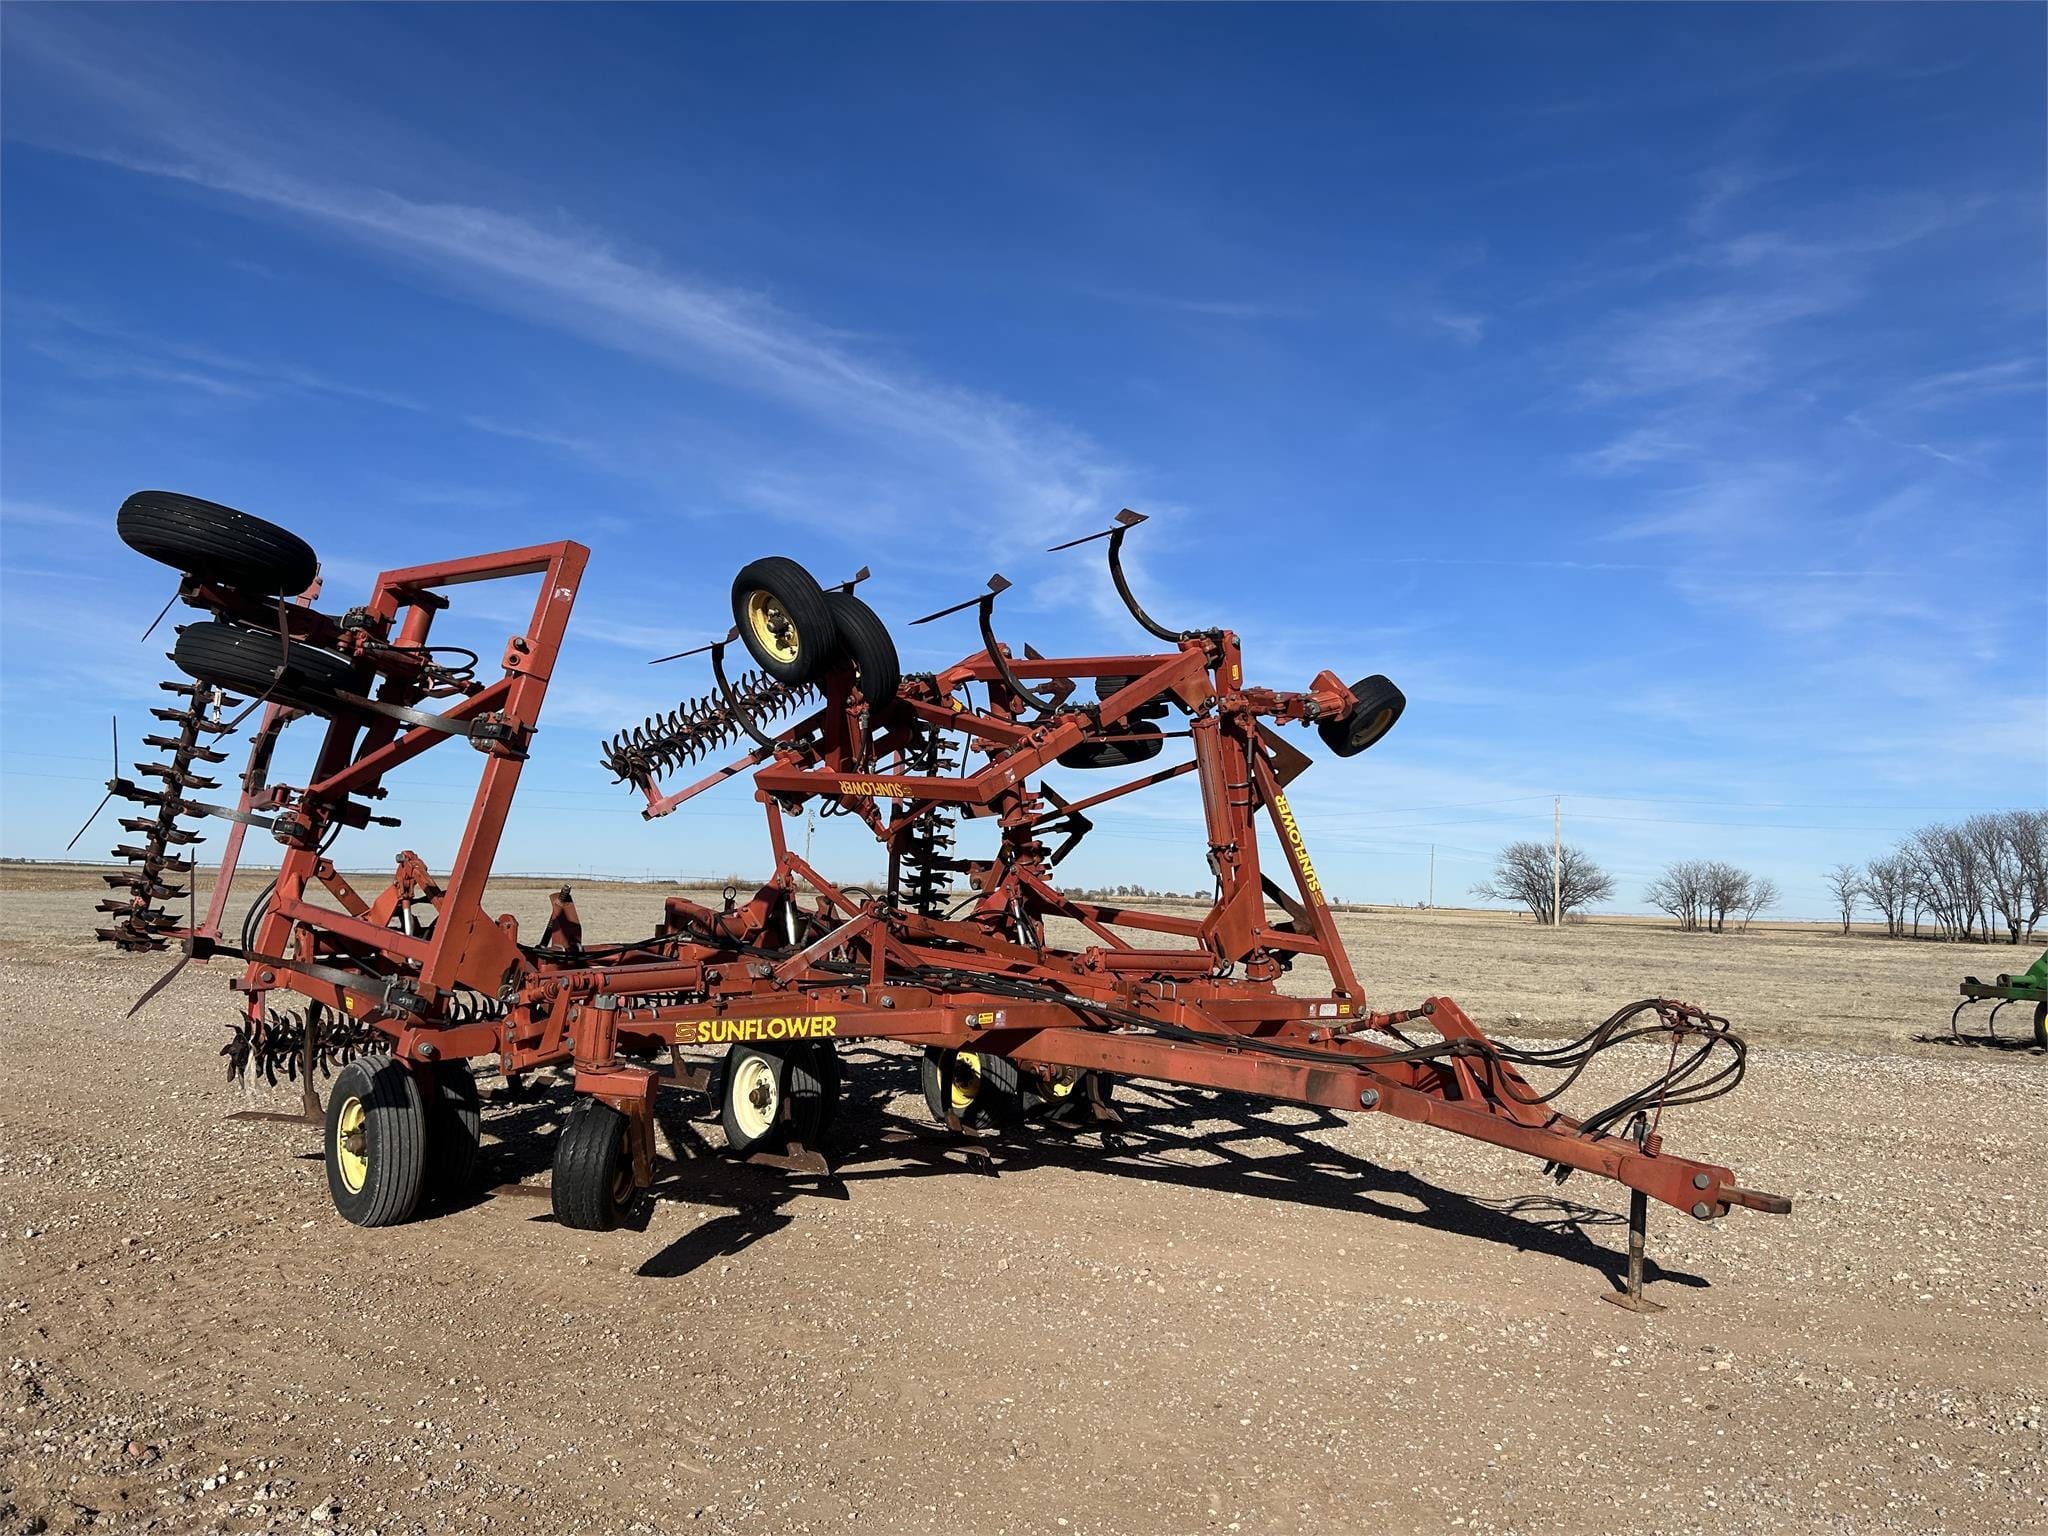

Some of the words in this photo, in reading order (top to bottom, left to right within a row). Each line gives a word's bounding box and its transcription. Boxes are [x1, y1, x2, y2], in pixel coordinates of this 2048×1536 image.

[839, 781, 904, 797] SUNFLOWER
[1275, 794, 1320, 892] SUNFLOWER
[697, 1016, 837, 1043] SUNFLOWER
